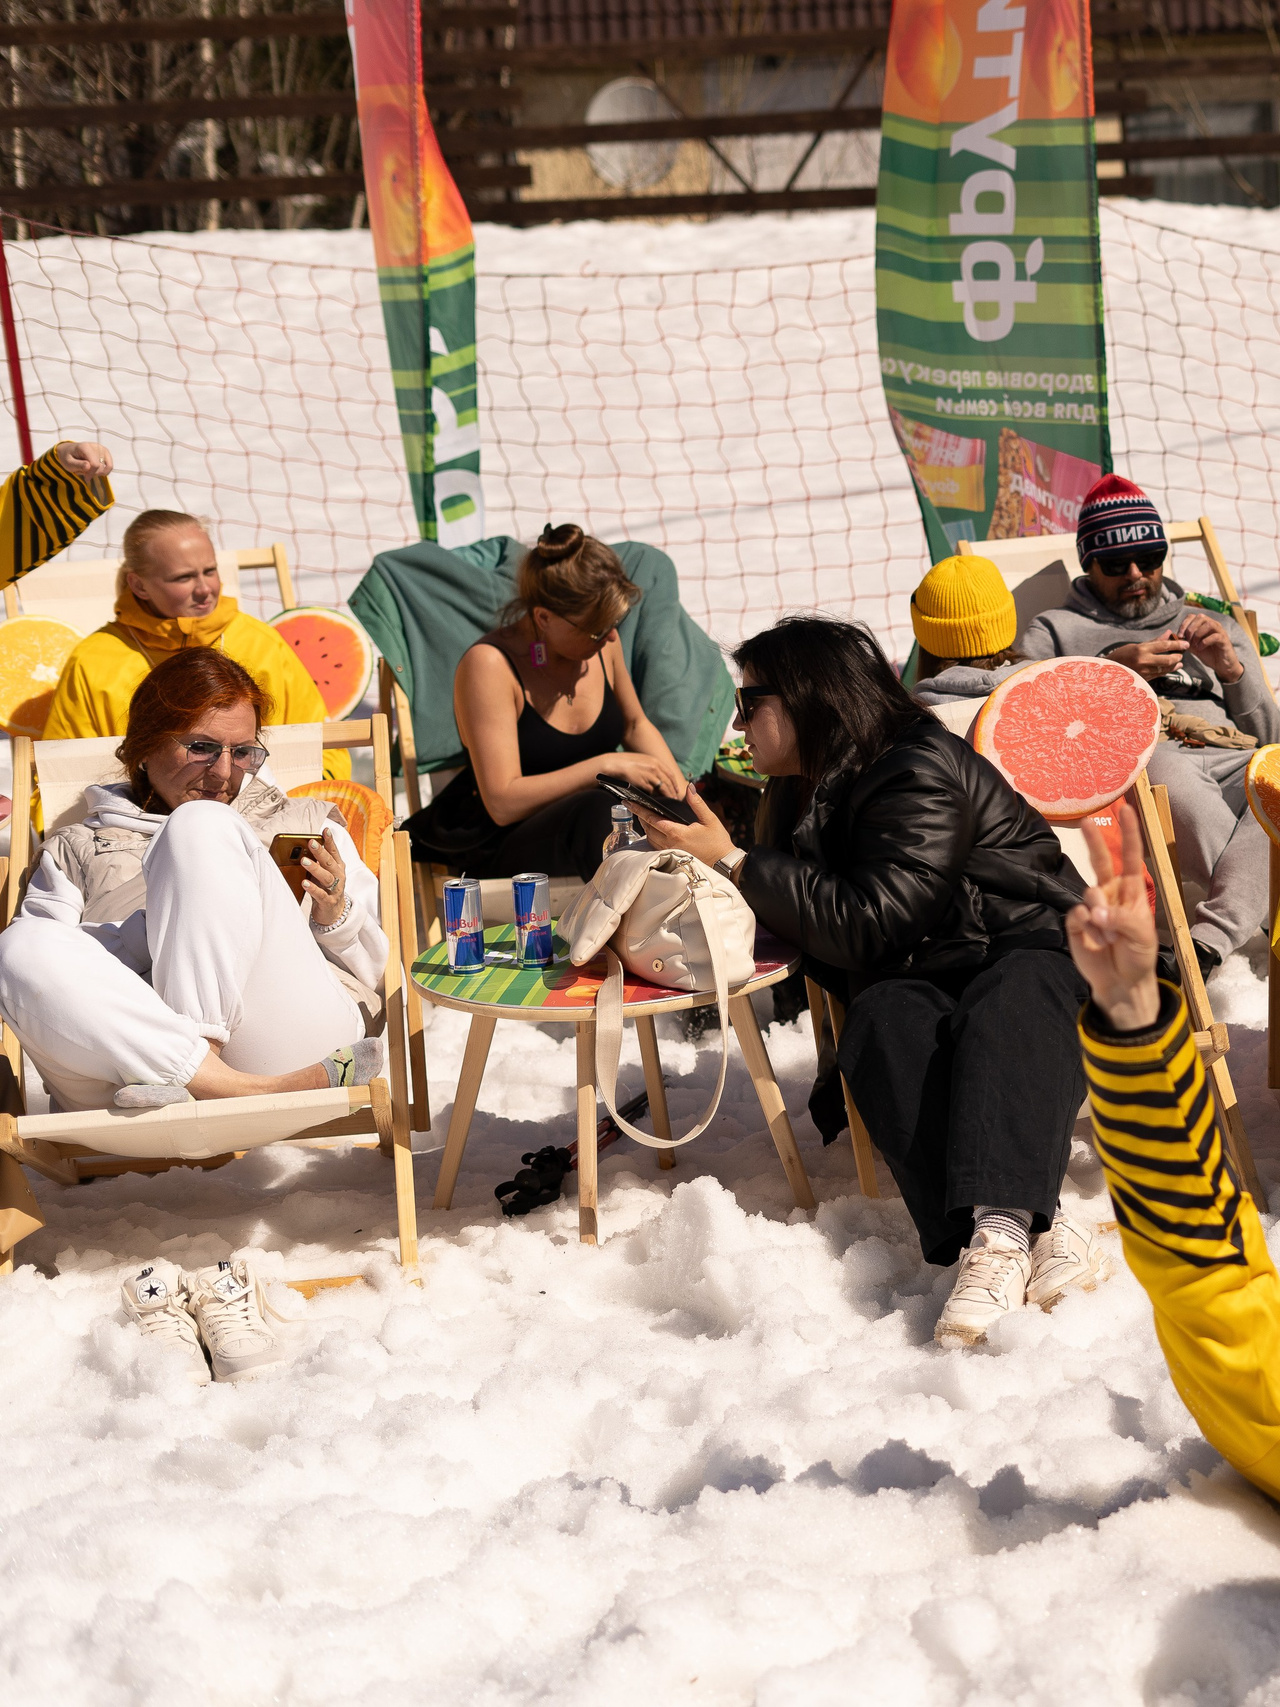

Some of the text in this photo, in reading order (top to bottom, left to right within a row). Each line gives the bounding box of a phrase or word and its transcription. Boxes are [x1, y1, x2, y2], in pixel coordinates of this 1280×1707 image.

[1094, 524, 1159, 547] СПИРТ
[516, 909, 549, 922] ed Bull
[446, 916, 479, 929] ed Bull
